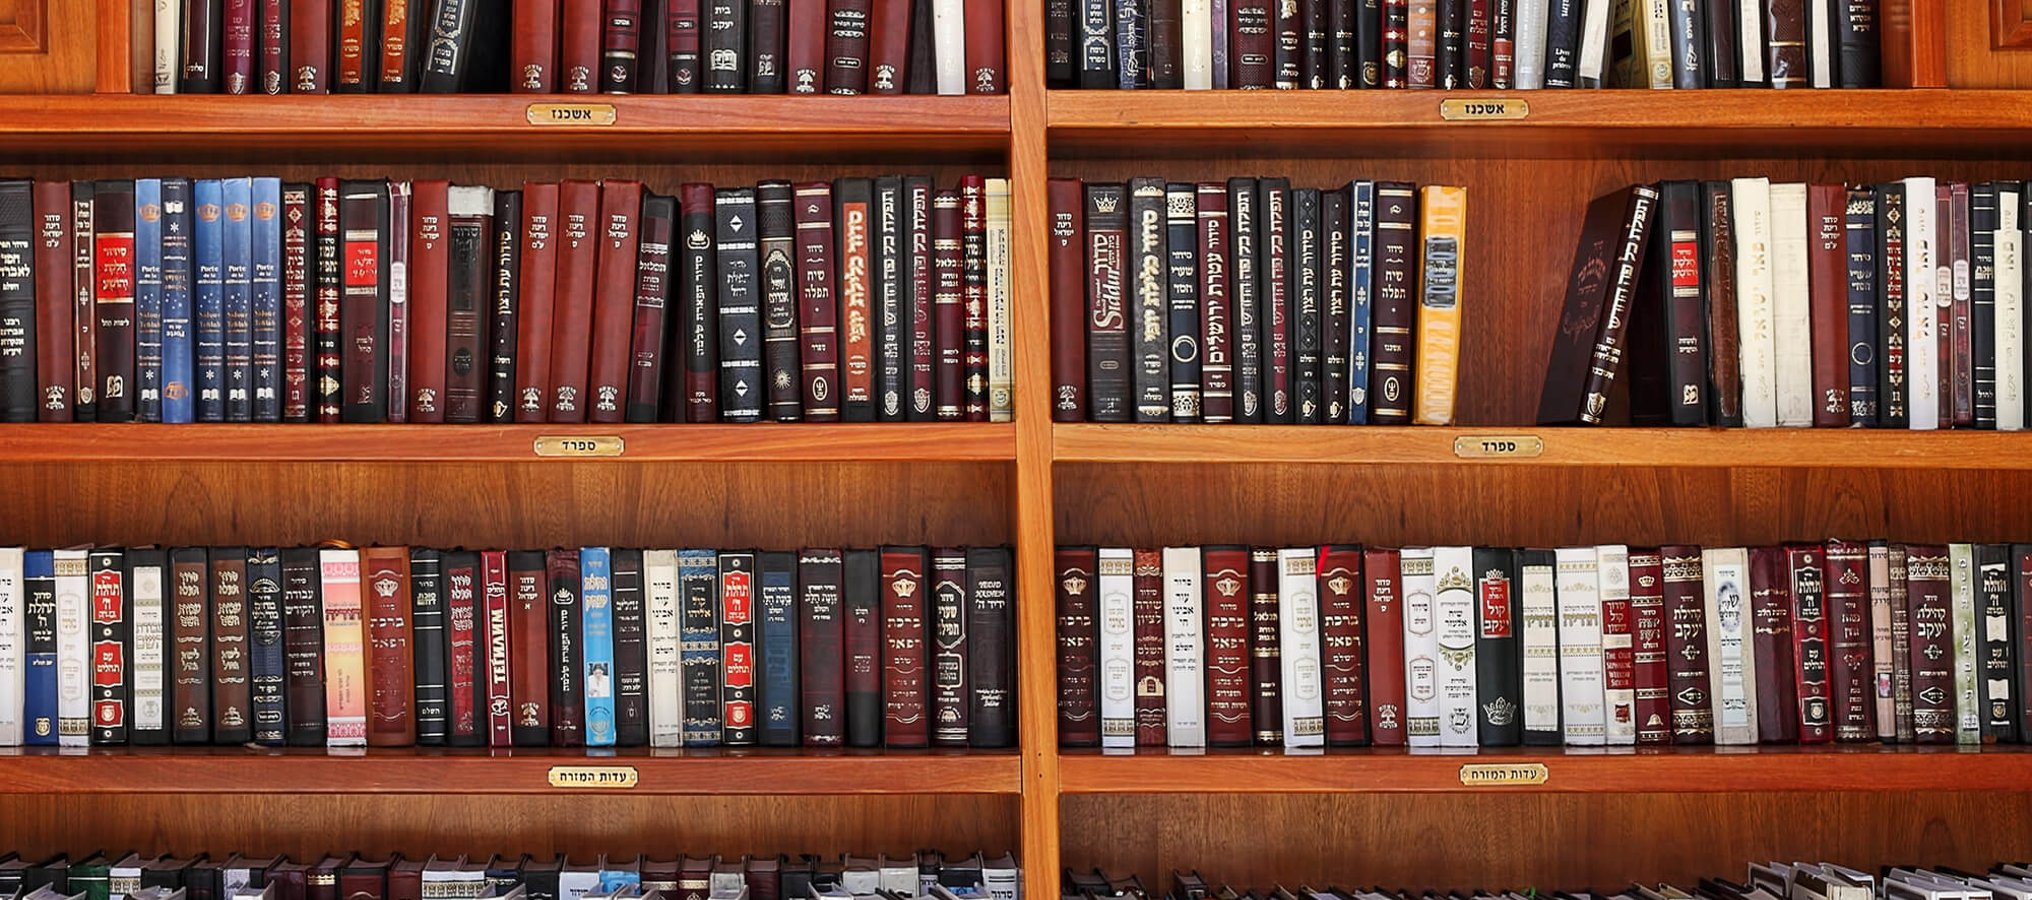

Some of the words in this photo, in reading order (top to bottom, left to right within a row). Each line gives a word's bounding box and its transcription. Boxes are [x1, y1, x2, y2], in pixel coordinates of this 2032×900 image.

[715, 6, 731, 14] בית
[711, 21, 734, 30] יעקב
[550, 108, 592, 120] אשכנז
[1465, 104, 1505, 114] אשכנז
[882, 191, 895, 232] תפלת
[913, 188, 925, 229] תפלת
[1238, 191, 1250, 232] תפלת
[1269, 190, 1282, 232] תפלת
[45, 214, 60, 222] סדור
[422, 216, 437, 224] סדור
[569, 215, 584, 223] סדור
[611, 214, 627, 222] סדור
[1056, 213, 1072, 221] סדור
[1624, 198, 1650, 235] תפלת
[1822, 216, 1838, 224] סדור
[42, 229, 63, 238] ישראל
[419, 232, 439, 240] ישראל
[529, 231, 549, 239] ישראל
[566, 230, 586, 238] ישראל
[608, 230, 628, 238] ישראל
[1054, 228, 1074, 236] ישראל
[1208, 219, 1220, 249] סידור
[1820, 231, 1840, 239] ישראל
[807, 244, 824, 253] סידור
[883, 236, 896, 255] כל
[913, 233, 926, 253] כל
[1238, 235, 1252, 256] כל
[1271, 235, 1283, 255] כל
[1302, 229, 1315, 265] סידור
[1330, 230, 1343, 266] סידור
[1386, 244, 1404, 253] סידור
[1093, 233, 1109, 275] סדור
[1618, 239, 1639, 262] כל
[694, 255, 703, 282] סדור
[1171, 266, 1194, 276] שערי
[807, 270, 825, 281] שיח
[1207, 251, 1225, 298] עטרת
[1302, 267, 1315, 286] עת
[1330, 269, 1343, 288] עת
[1385, 270, 1403, 281] שיח
[805, 286, 829, 299] תפלה
[1173, 284, 1193, 293] חסד
[1382, 286, 1406, 299] תפלה
[694, 285, 704, 322] תפארת
[1093, 268, 1124, 330] Siddur
[1302, 288, 1317, 315] רצון
[1330, 289, 1344, 316] רצון
[1206, 300, 1225, 364] ירושלים
[562, 441, 596, 451] ספרד
[1482, 442, 1516, 452] ספרד
[519, 576, 535, 584] סדור
[1375, 578, 1391, 586] סדור
[285, 590, 314, 600] עבודת
[517, 592, 538, 600] ישראל
[1139, 588, 1158, 596] סידור
[1372, 594, 1394, 603] ישראל
[285, 604, 315, 617] הקודש
[1486, 600, 1505, 618] קול
[1673, 605, 1701, 621] קהילת
[1916, 603, 1946, 620] קהילת
[1324, 615, 1359, 627] ברכת
[1609, 609, 1624, 622] קול
[1058, 616, 1092, 627] ברכת
[1210, 616, 1245, 628] ברכת
[1483, 619, 1511, 634] יעקב
[1674, 623, 1702, 641] יעקב
[1917, 621, 1947, 640] יעקב
[887, 634, 922, 649] רפאל
[1058, 632, 1092, 647] רפאל
[1210, 633, 1246, 649] רפאל
[1325, 632, 1361, 648] רפאל
[561, 632, 571, 663] תפארת
[1137, 644, 1164, 655] השלם
[1991, 648, 2002, 657] עם
[103, 652, 113, 662] עם
[733, 653, 744, 662] עם
[1809, 649, 1818, 658] עם
[97, 662, 120, 673] תהלים
[1803, 660, 1825, 670] תהלים
[1986, 657, 2008, 669] תהלים
[727, 664, 750, 674] תהלים
[421, 706, 441, 715] השלם
[560, 772, 595, 782] המזרח
[600, 772, 627, 783] עדות
[1471, 770, 1506, 780] המזרח
[1511, 769, 1537, 780] עדות
[991, 890, 1013, 899] סדור
